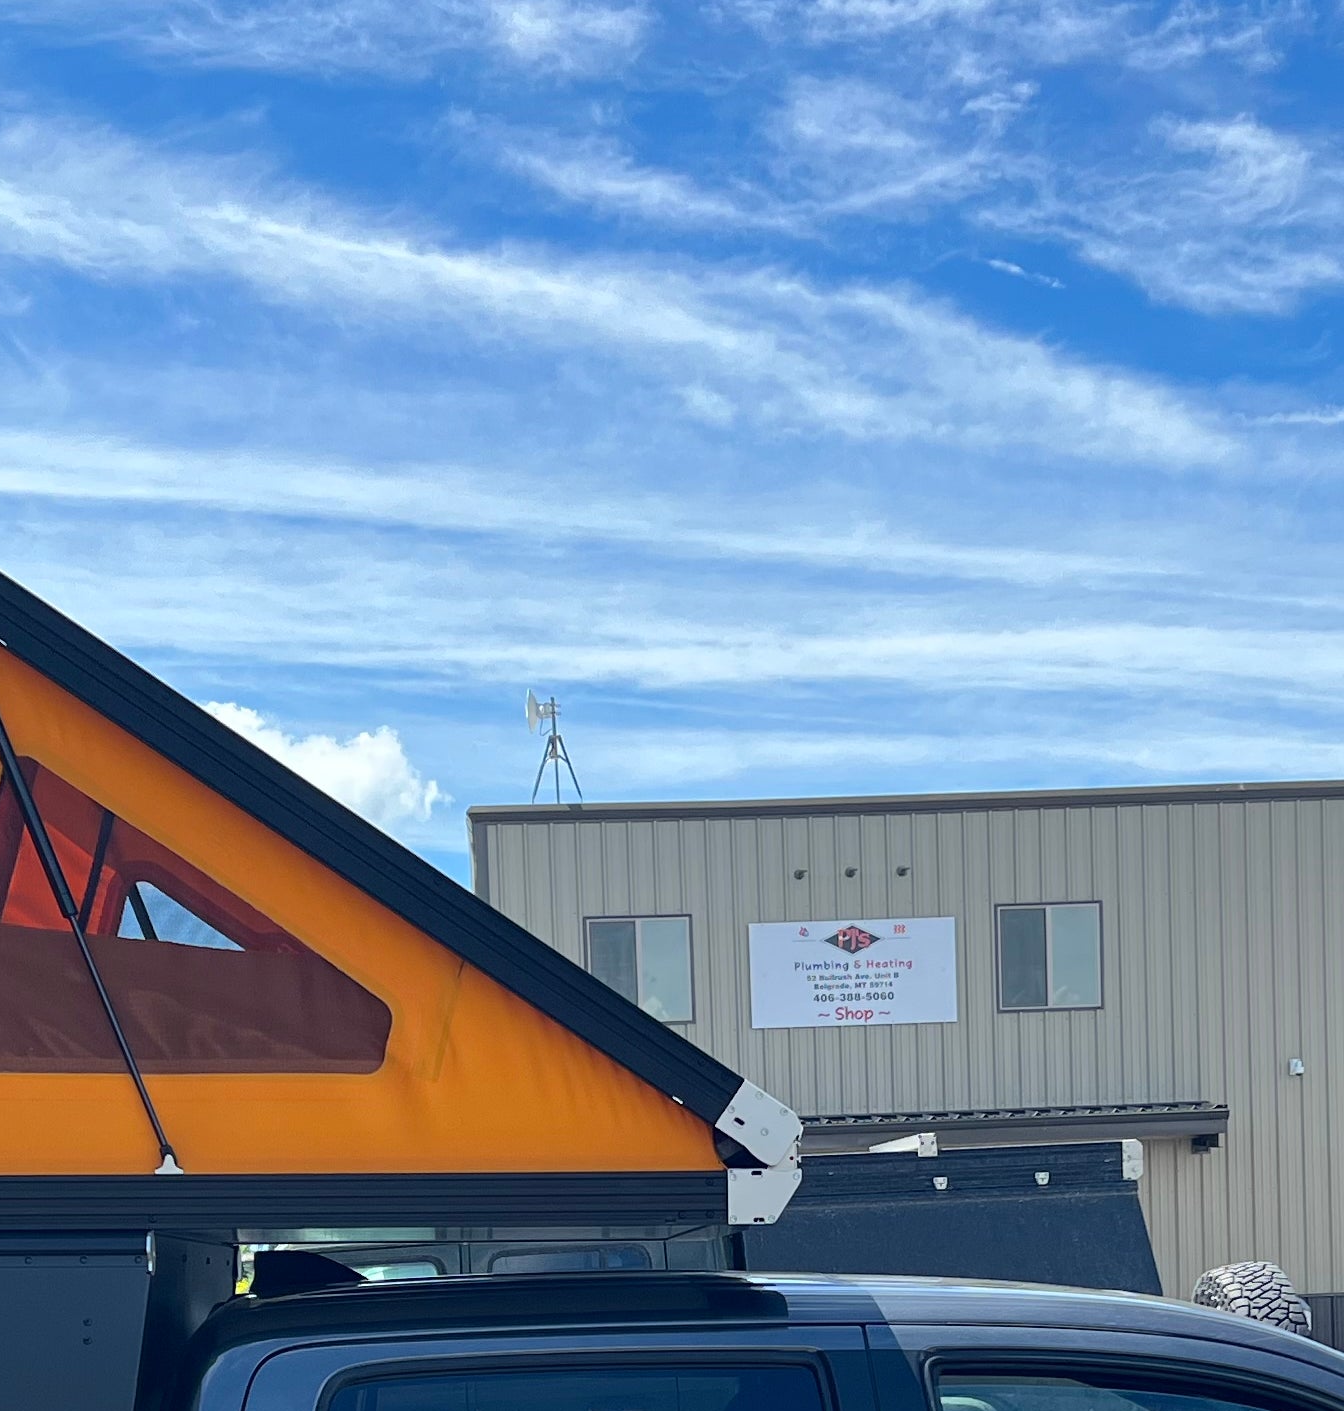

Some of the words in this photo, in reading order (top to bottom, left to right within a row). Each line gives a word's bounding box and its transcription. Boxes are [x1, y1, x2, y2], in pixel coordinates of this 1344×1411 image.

[794, 961, 849, 971] Plumbing
[853, 961, 862, 969] &
[866, 960, 913, 969] Heating
[835, 1006, 874, 1023] Shop
